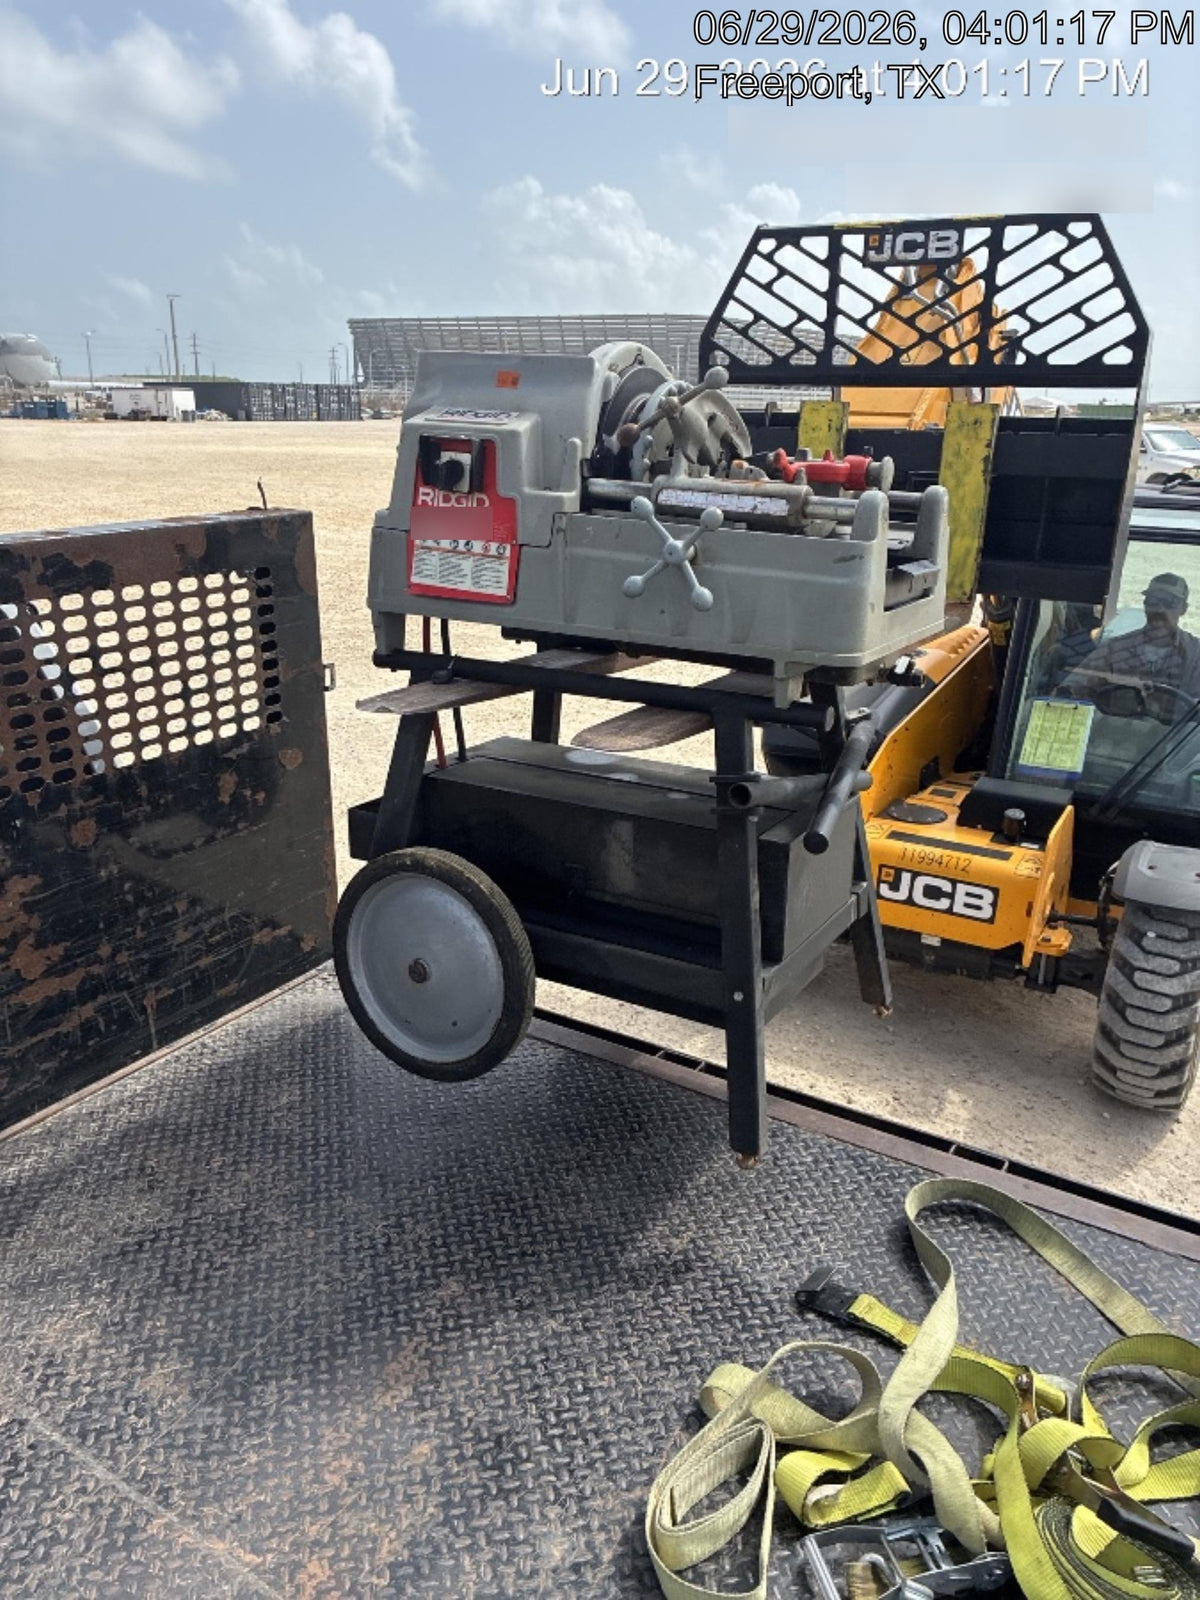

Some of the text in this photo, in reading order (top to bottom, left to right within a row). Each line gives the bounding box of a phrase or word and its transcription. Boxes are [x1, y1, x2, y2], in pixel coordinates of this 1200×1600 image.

[867, 229, 960, 262] JCB
[417, 486, 490, 508] RIDGID
[900, 847, 972, 873] 11994712
[879, 870, 996, 920] JCB
